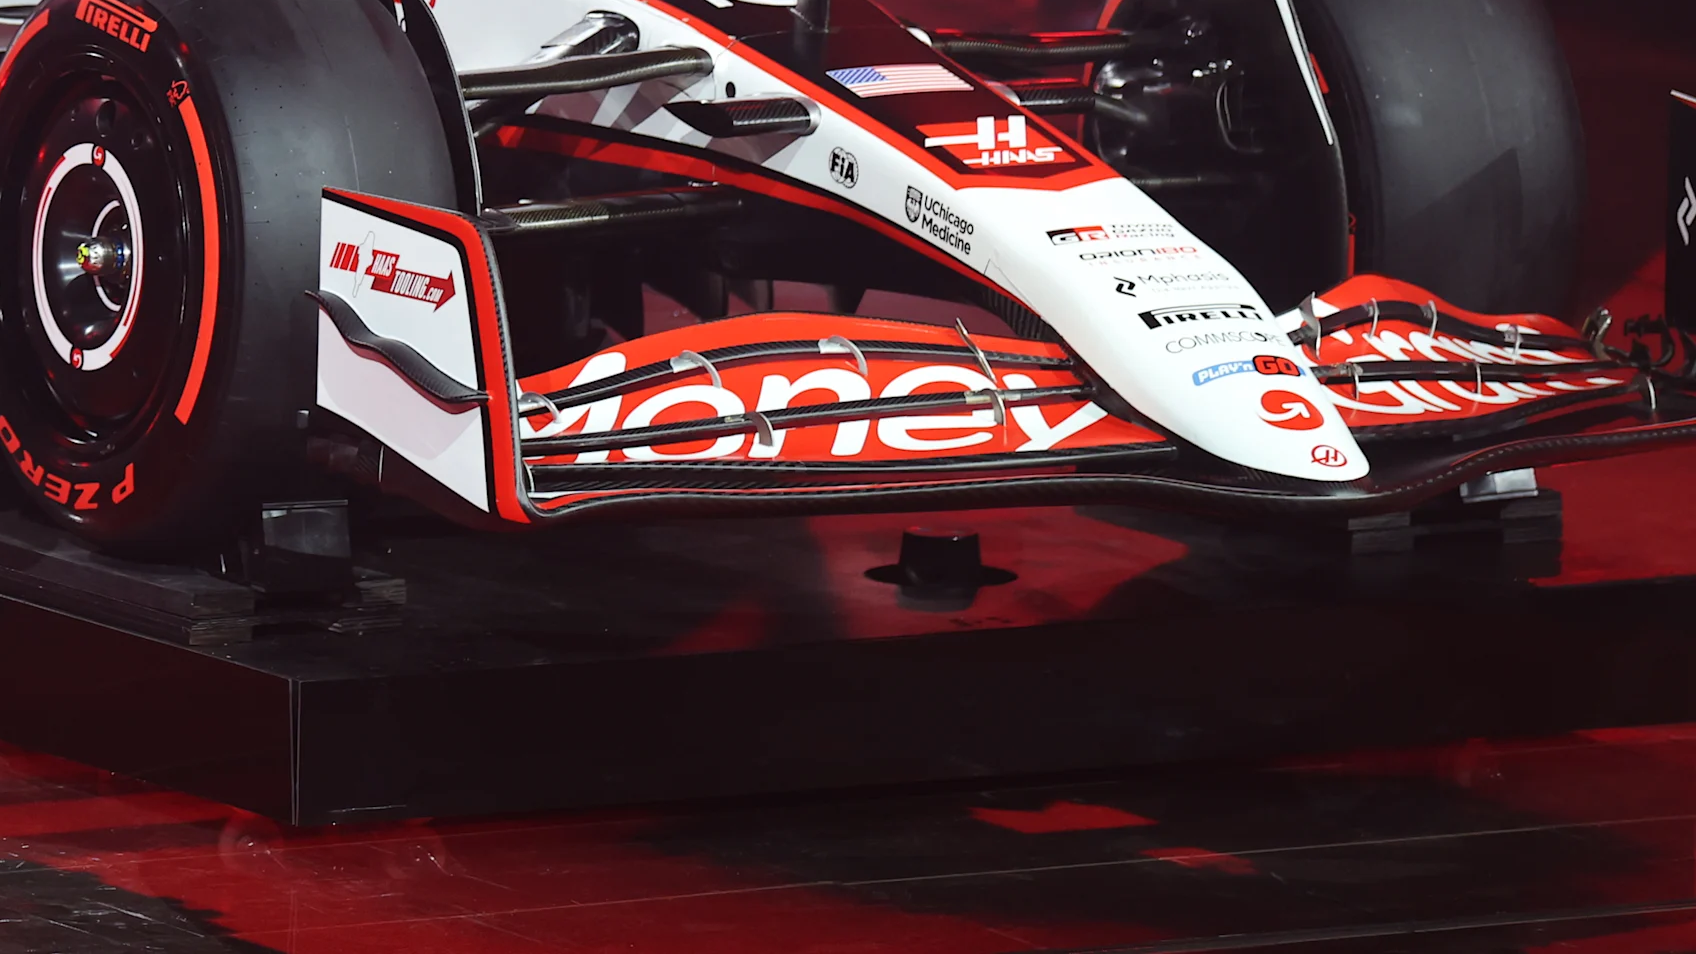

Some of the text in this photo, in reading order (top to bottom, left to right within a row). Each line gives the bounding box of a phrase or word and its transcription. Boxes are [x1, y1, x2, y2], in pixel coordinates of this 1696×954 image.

[962, 146, 1064, 166] HAAS
[923, 195, 975, 236] UChicago
[921, 214, 972, 256] Medicine
[370, 253, 397, 278] HAAS
[1079, 246, 1198, 261] ORION180
[1137, 271, 1230, 287] Mphasis
[1138, 302, 1264, 330] PIRELLI
[1165, 330, 1286, 354] COMMSCOPE
[1252, 354, 1301, 377] GO
[516, 351, 1108, 464] Money
